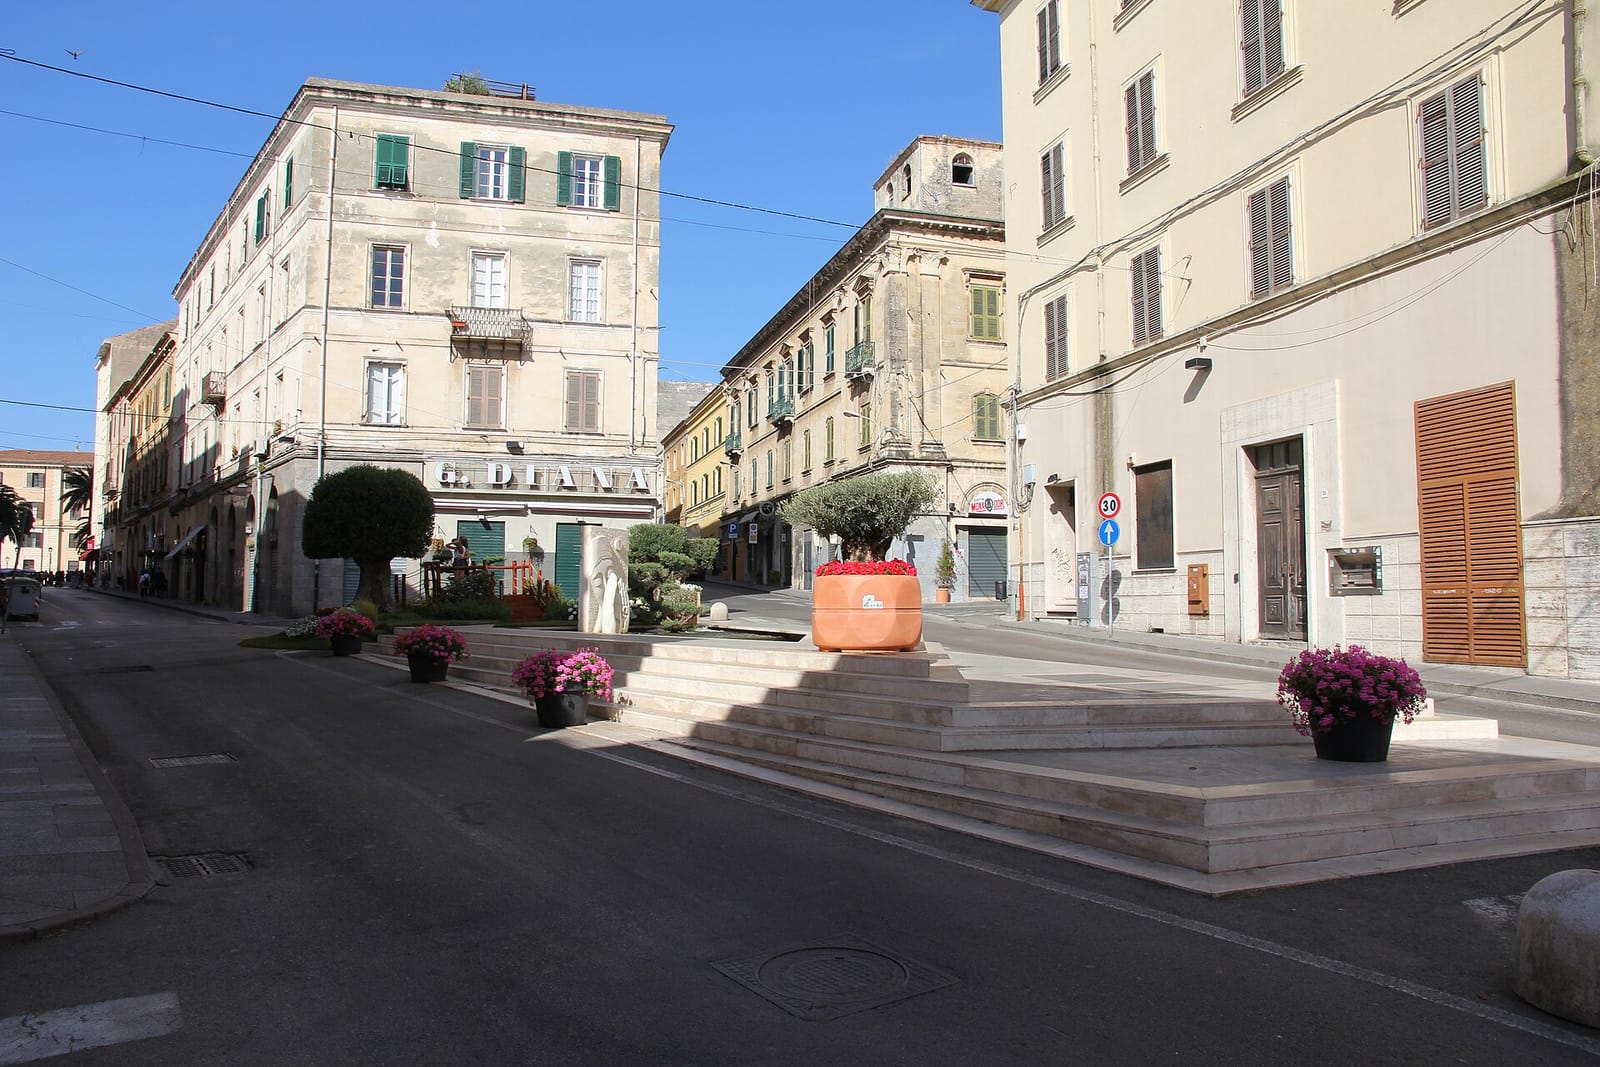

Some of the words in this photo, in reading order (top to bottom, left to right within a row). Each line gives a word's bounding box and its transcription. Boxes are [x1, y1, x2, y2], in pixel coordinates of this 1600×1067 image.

[435, 462, 469, 483] G.
[486, 462, 649, 490] DIANA
[1103, 500, 1116, 512] 30
[729, 523, 737, 533] P
